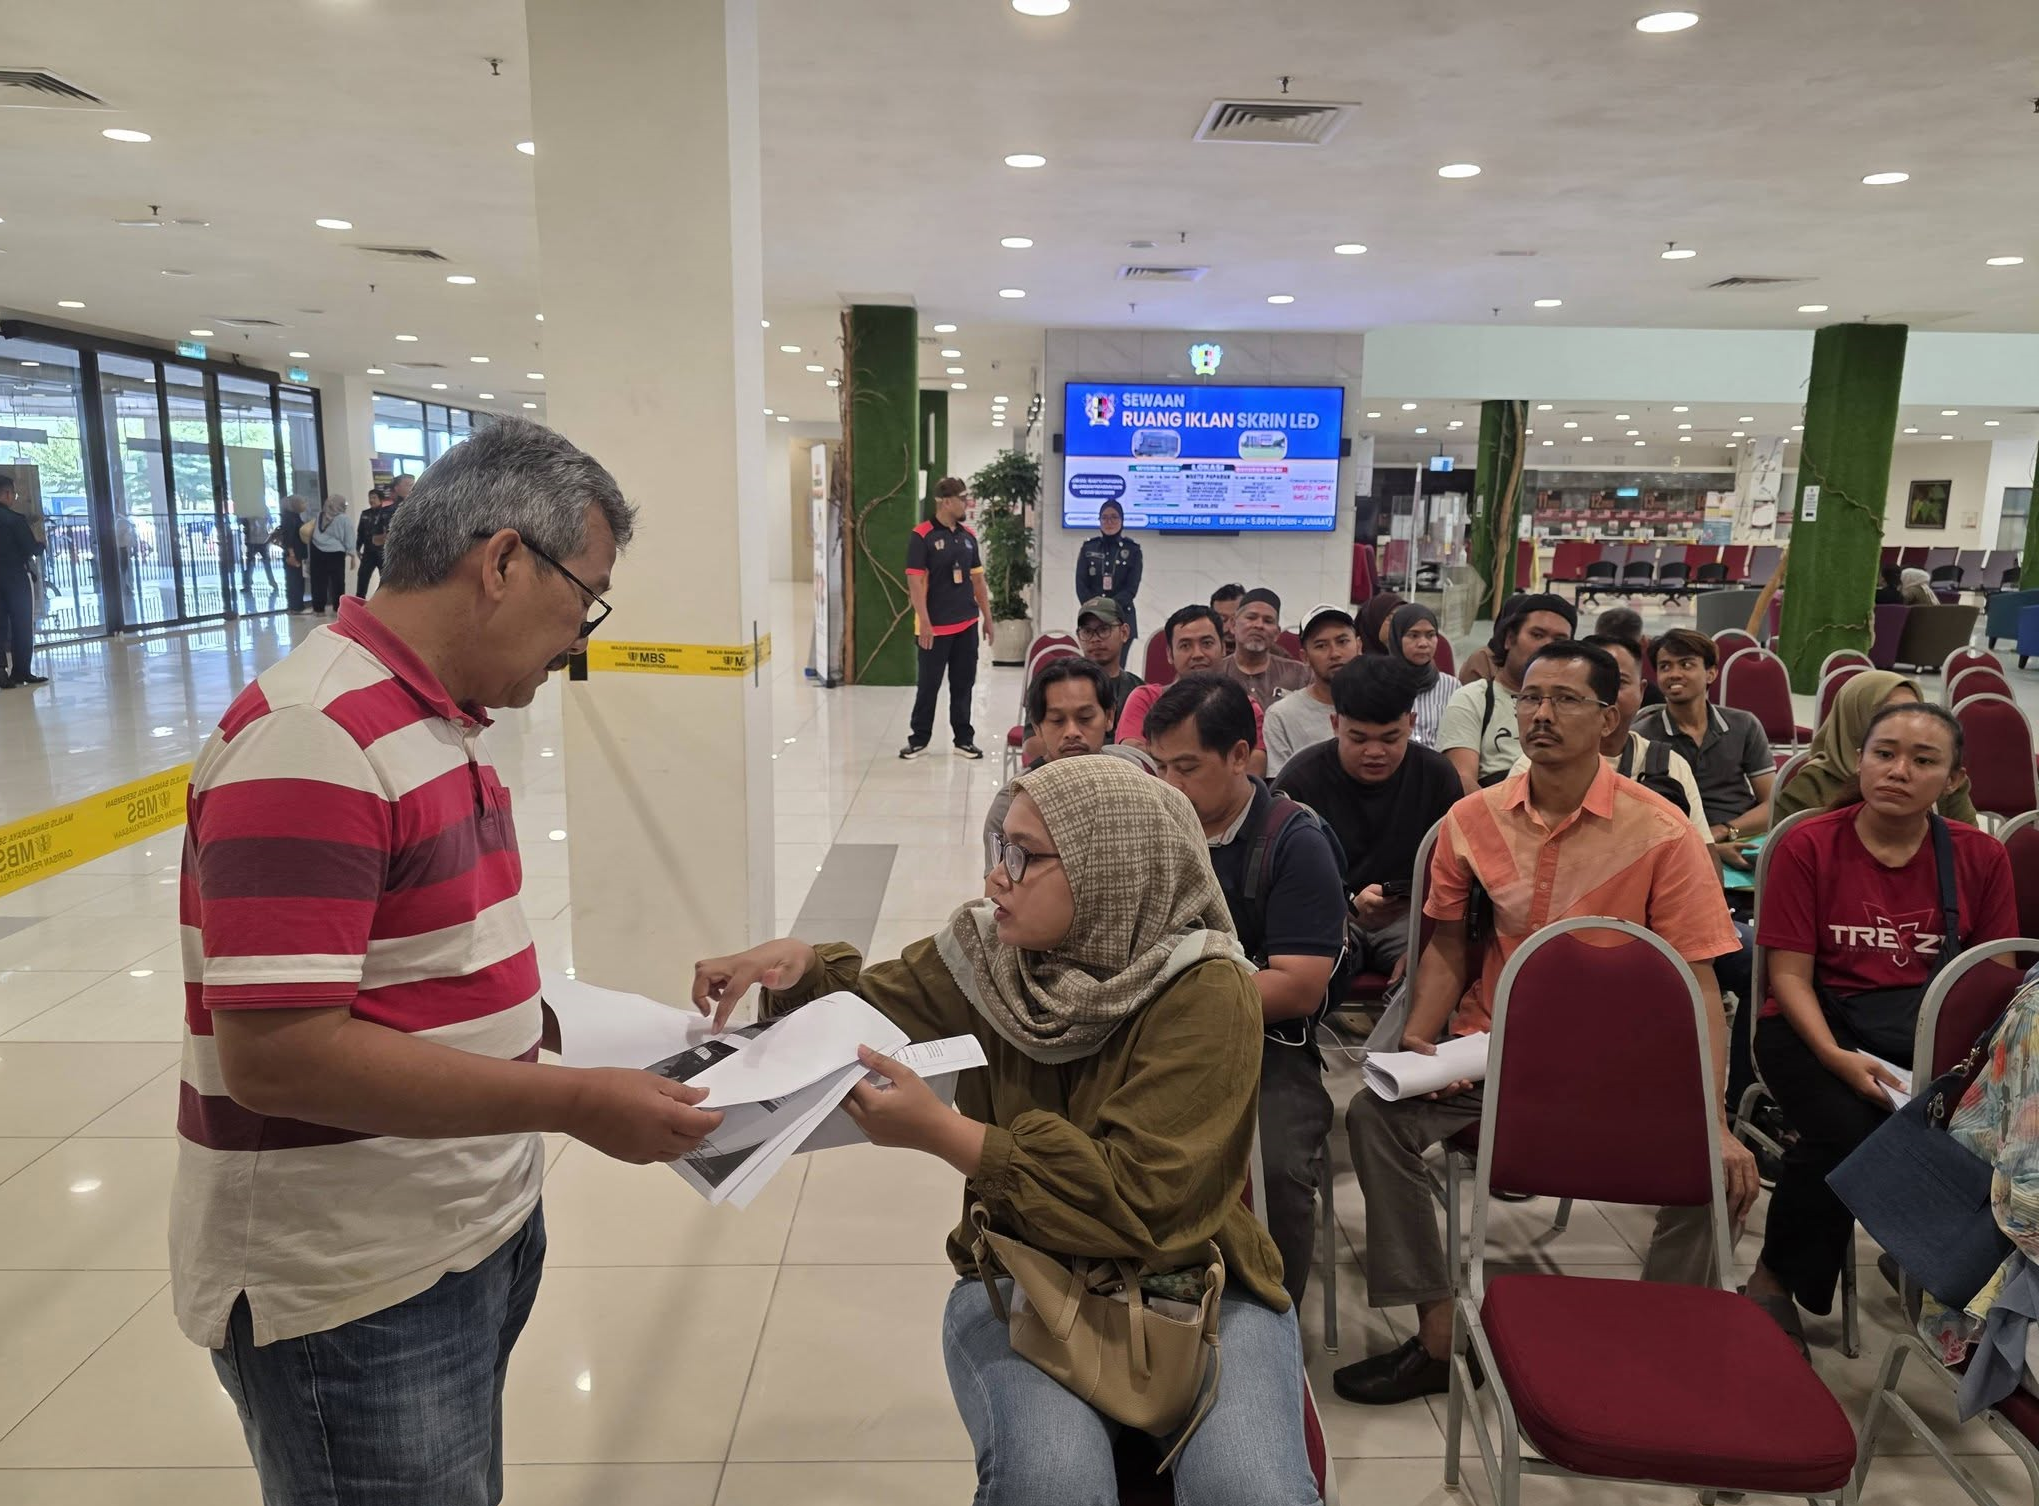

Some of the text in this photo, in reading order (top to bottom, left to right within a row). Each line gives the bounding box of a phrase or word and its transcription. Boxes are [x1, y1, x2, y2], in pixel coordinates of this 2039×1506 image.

[1122, 393, 1185, 408] SEWAAN
[1122, 411, 1320, 429] RUANG IKLAN SKRIN LED
[1191, 463, 1225, 472] LOKASI
[639, 652, 666, 664] MBS
